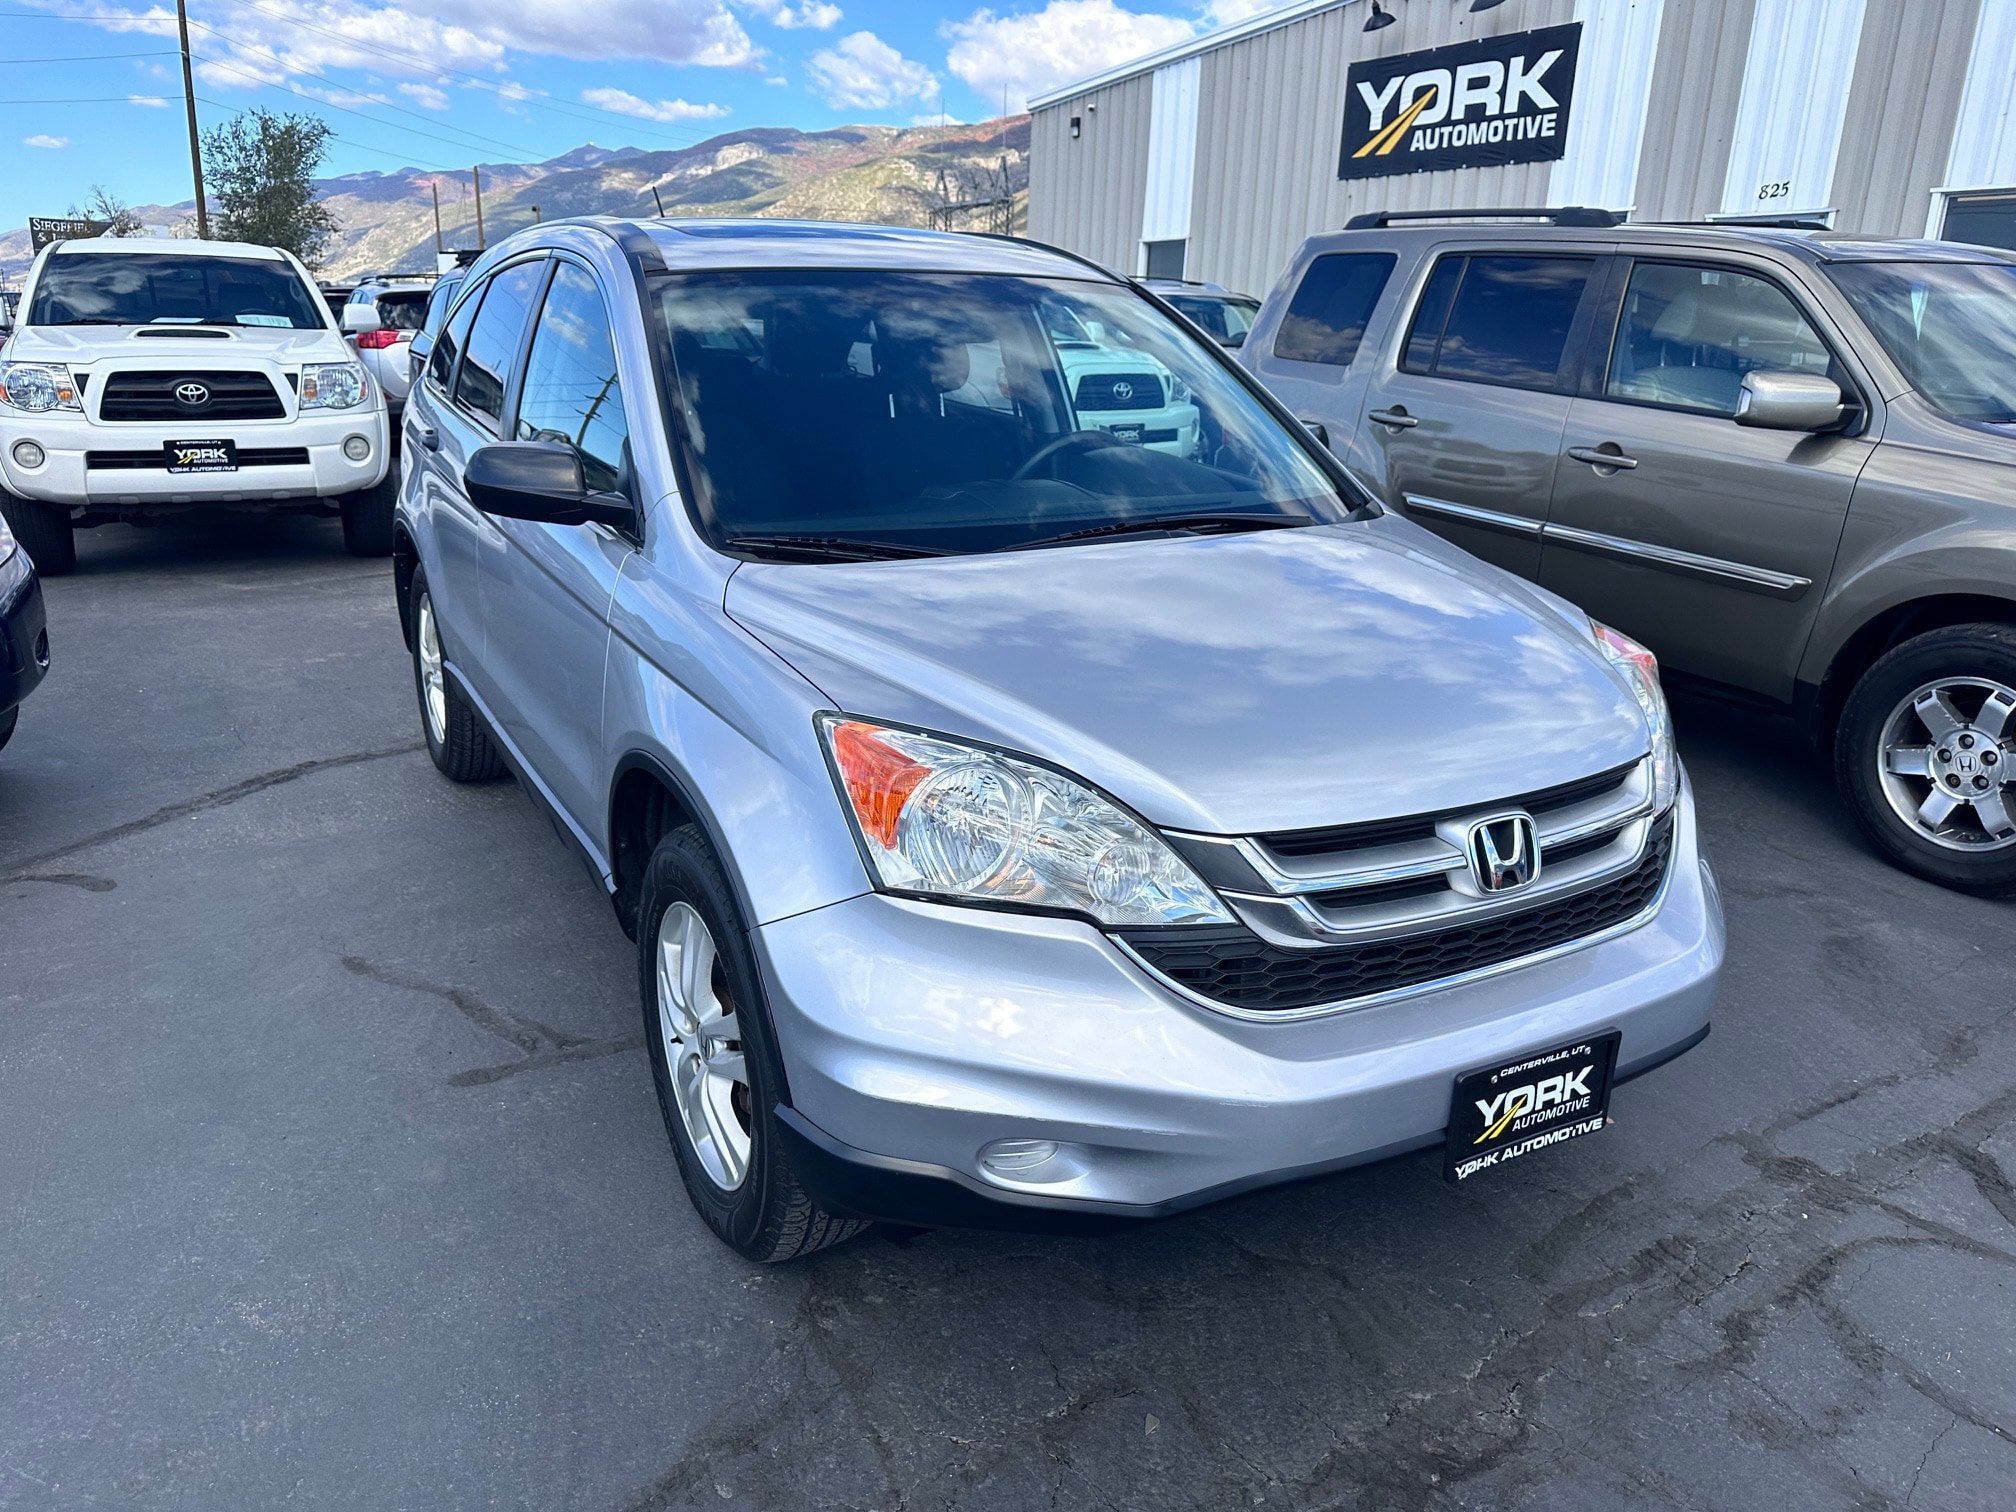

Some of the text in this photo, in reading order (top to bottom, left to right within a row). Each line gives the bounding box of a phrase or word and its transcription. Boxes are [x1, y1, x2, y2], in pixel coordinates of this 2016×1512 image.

[1356, 49, 1564, 131] YORK
[1410, 113, 1557, 152] AUTOMOTIVE
[1759, 181, 1790, 200] 825
[173, 448, 228, 459] YORK
[1500, 1045, 1586, 1077] CENTERVILLE, UT
[1475, 1065, 1594, 1128] YORK
[1512, 1096, 1591, 1132] AUTOMOTIVE
